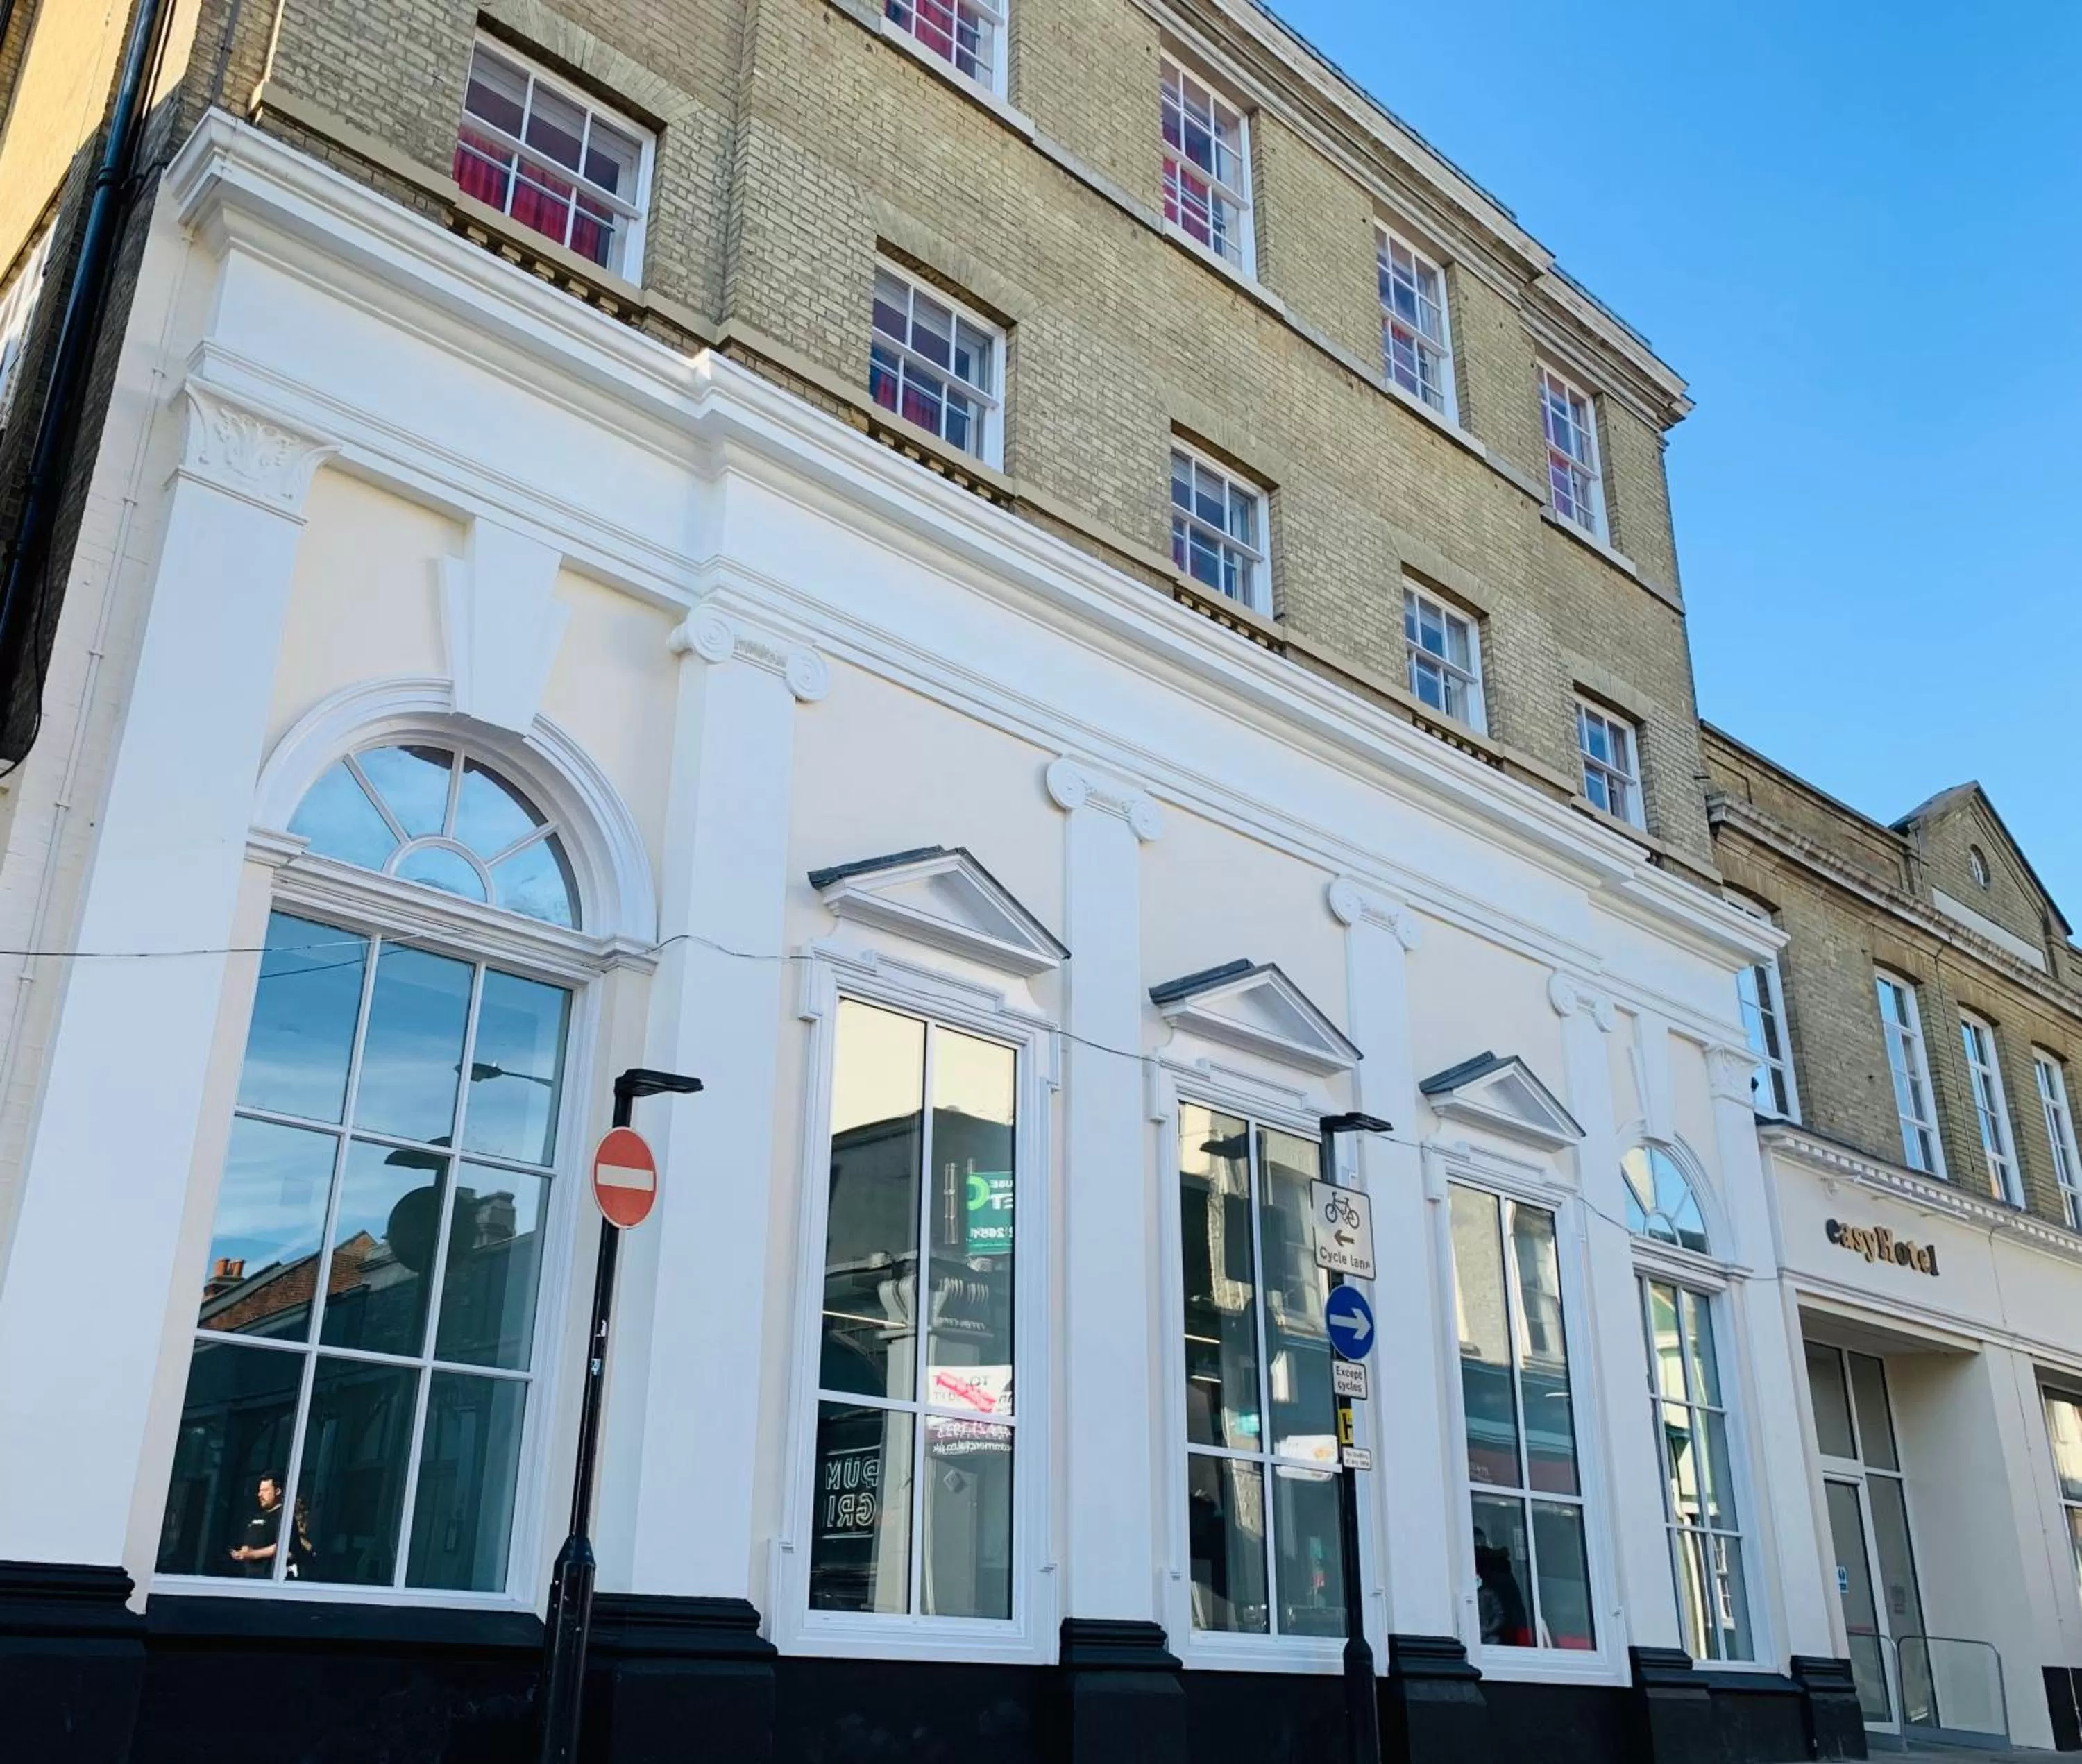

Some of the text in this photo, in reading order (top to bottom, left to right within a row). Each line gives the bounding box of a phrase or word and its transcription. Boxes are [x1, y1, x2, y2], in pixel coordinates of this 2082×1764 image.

[1826, 1219, 1940, 1276] easyHotel
[1320, 1246, 1371, 1269] Cycle lane
[1336, 1365, 1362, 1380] Except
[1337, 1380, 1362, 1393] cycles
